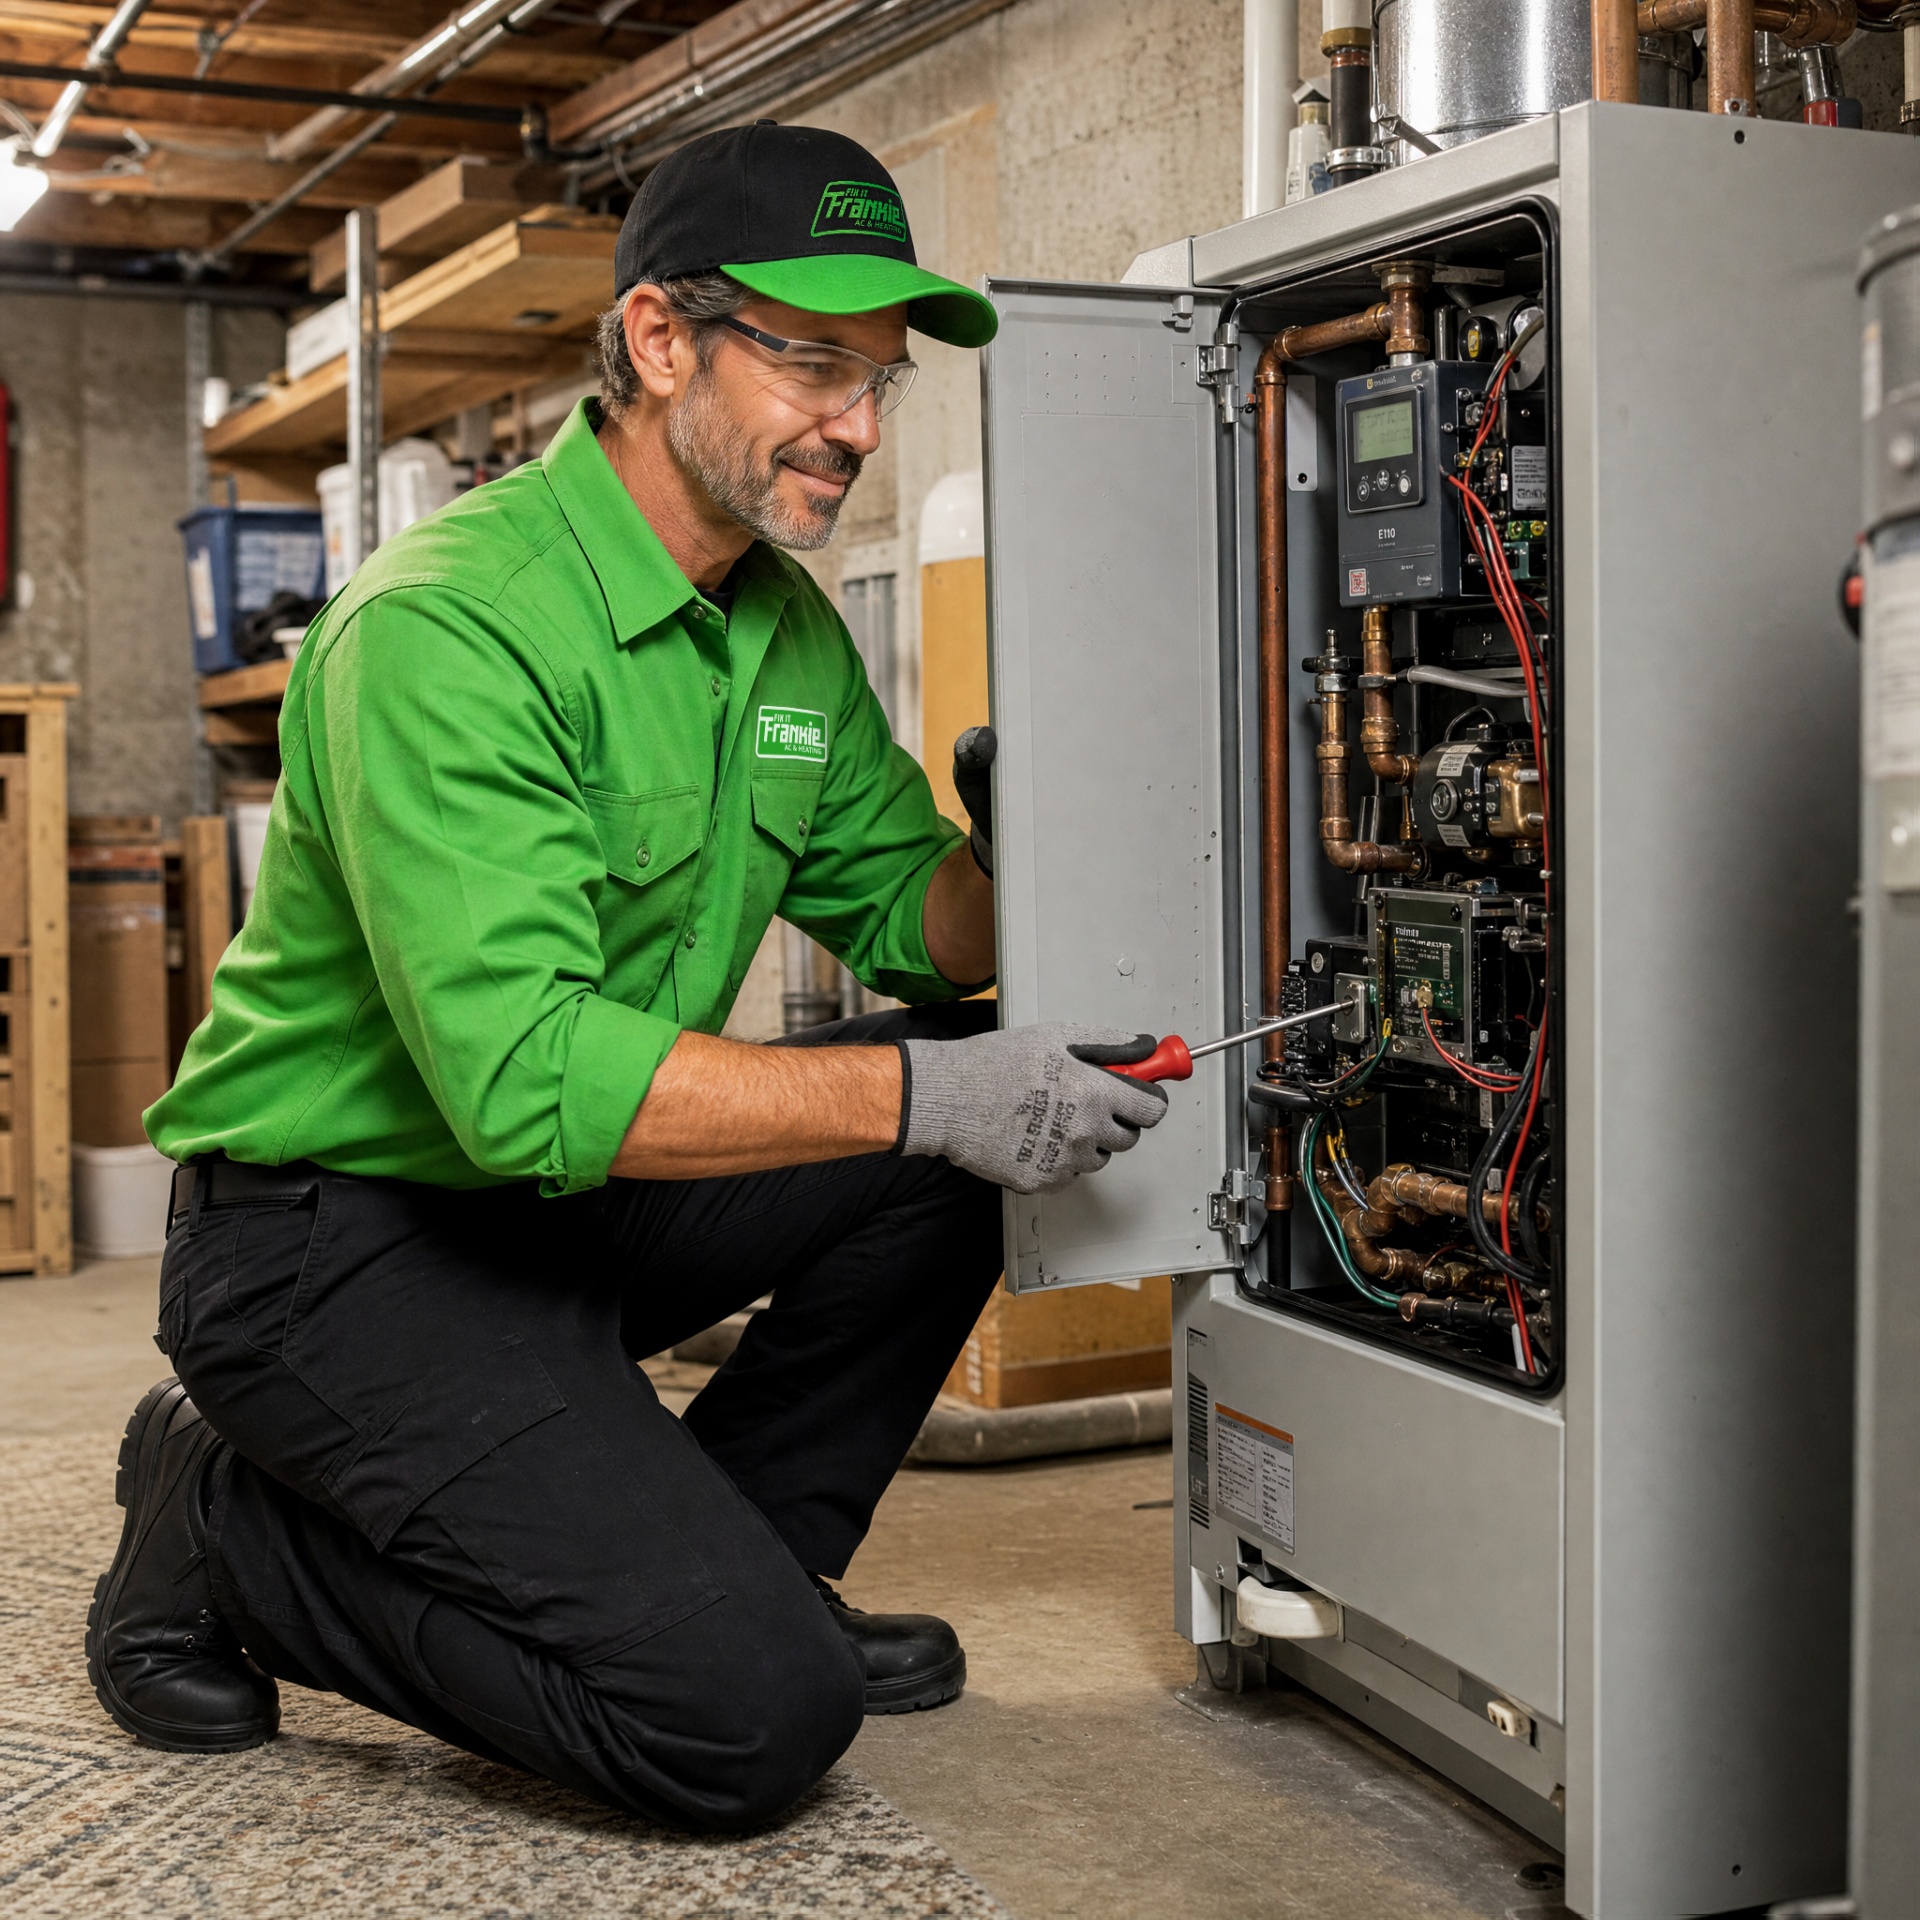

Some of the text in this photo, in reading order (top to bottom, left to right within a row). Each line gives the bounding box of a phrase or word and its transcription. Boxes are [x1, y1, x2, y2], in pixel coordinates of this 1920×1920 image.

[845, 188, 868, 197] FIX IT
[824, 192, 904, 227] Frankie
[866, 220, 873, 228] &
[874, 222, 902, 234] HEATING
[1378, 528, 1396, 540] E110
[774, 714, 791, 723] FIX IT
[760, 716, 826, 748] Frankie
[799, 746, 822, 755] HEATING
